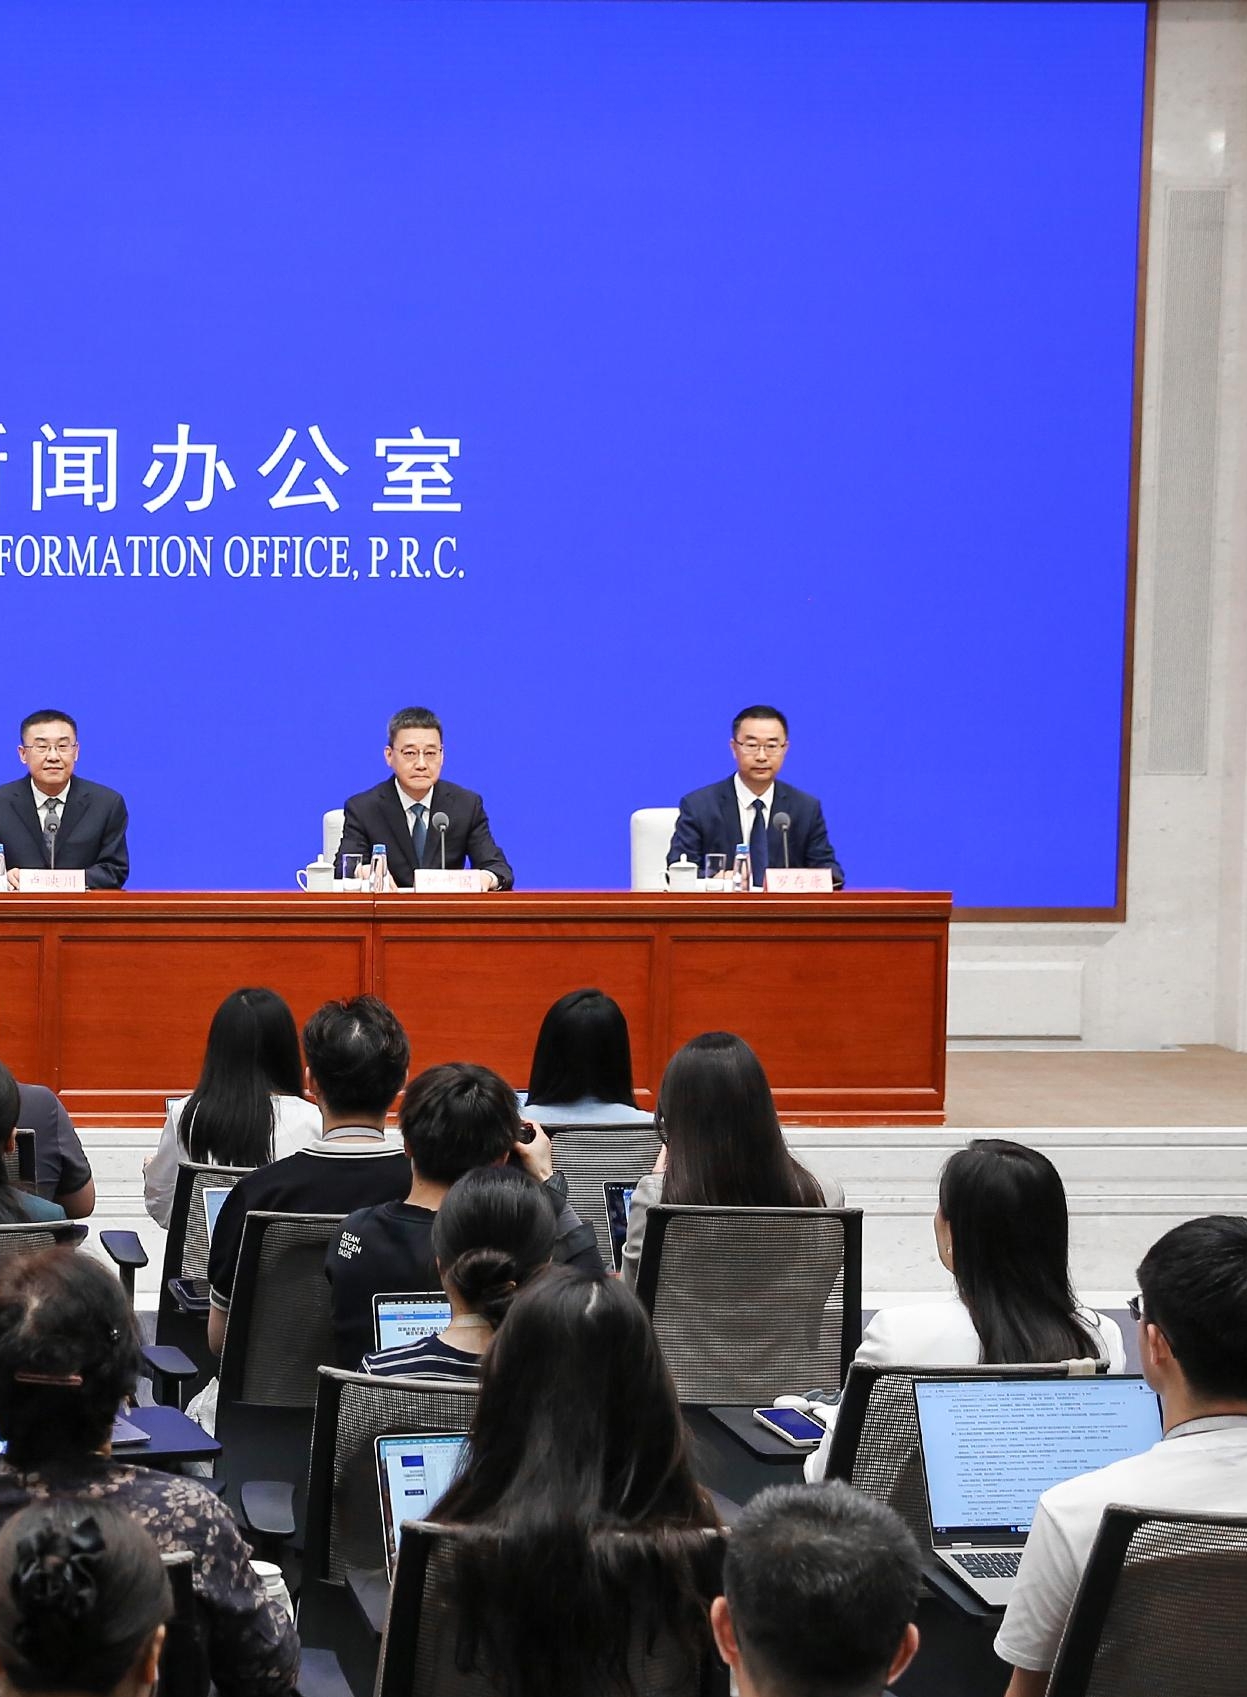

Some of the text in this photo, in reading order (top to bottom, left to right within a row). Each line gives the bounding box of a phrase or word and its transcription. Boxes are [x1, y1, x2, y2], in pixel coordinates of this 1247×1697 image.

[224, 535, 359, 581] OFFICE,
[368, 536, 465, 579] P.R.C.
[342, 1231, 361, 1245] OCEAN
[337, 1247, 353, 1260] OASIS
[339, 1239, 362, 1255] OXYGEN
